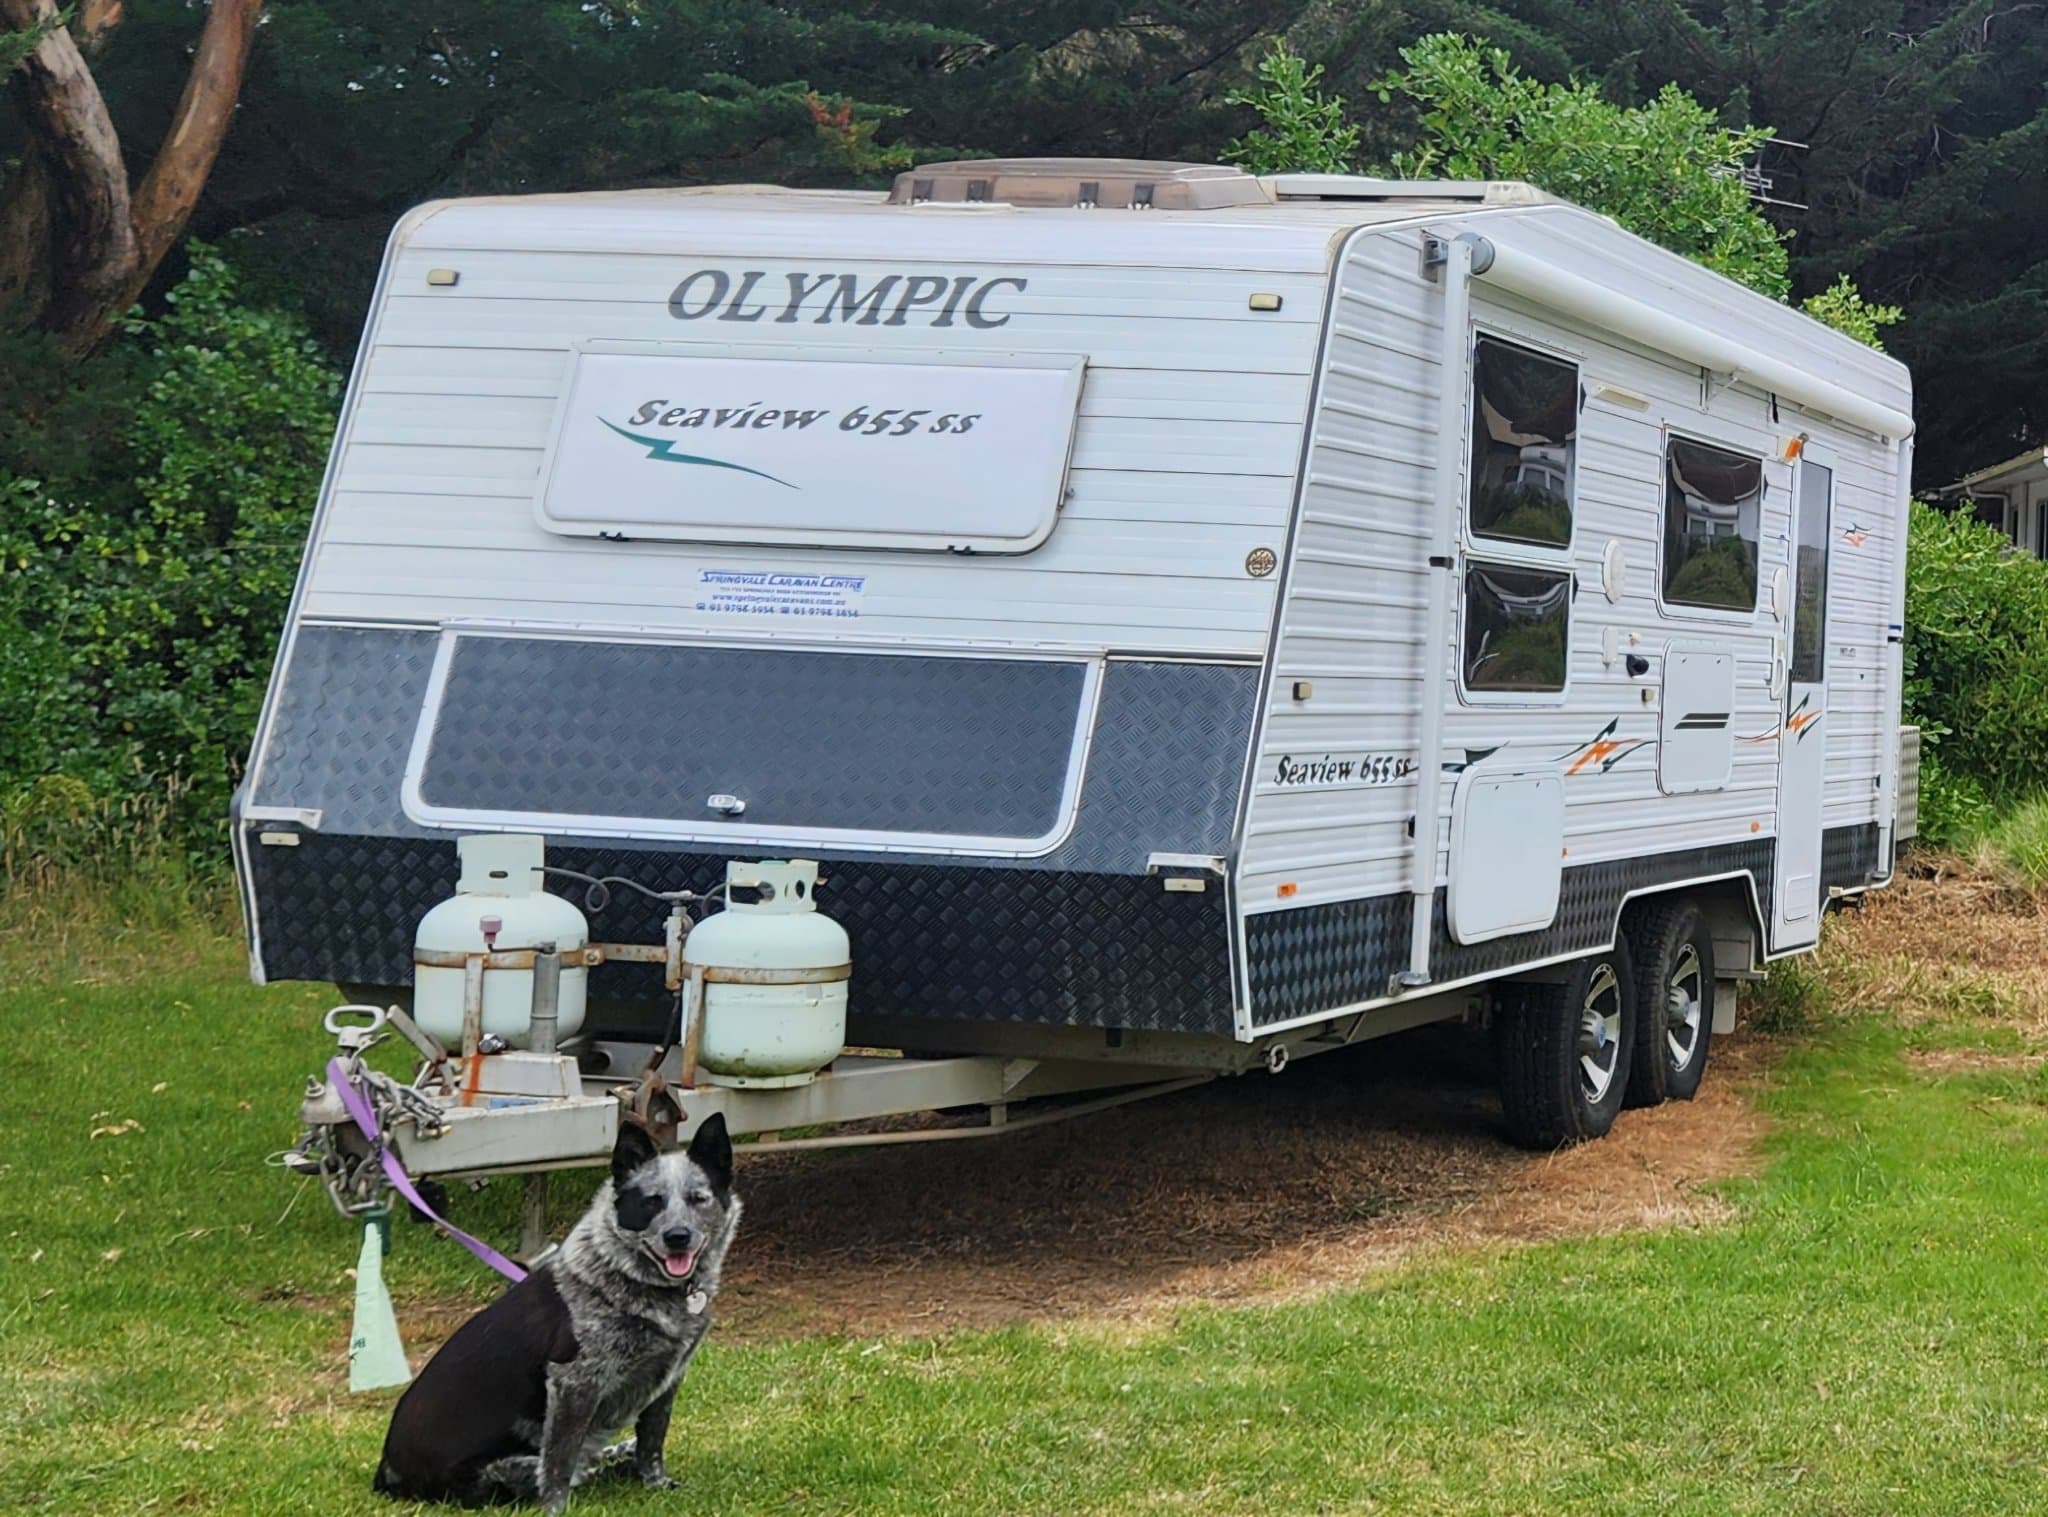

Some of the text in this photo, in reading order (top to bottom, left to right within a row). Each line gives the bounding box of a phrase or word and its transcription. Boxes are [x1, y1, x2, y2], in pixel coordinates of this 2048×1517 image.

[668, 269, 1028, 329] OLYMPIC
[628, 399, 831, 431] Seaview
[767, 574, 820, 587] CARAVAN
[820, 576, 865, 589] CENTRE
[1274, 754, 1355, 785] Seaview
